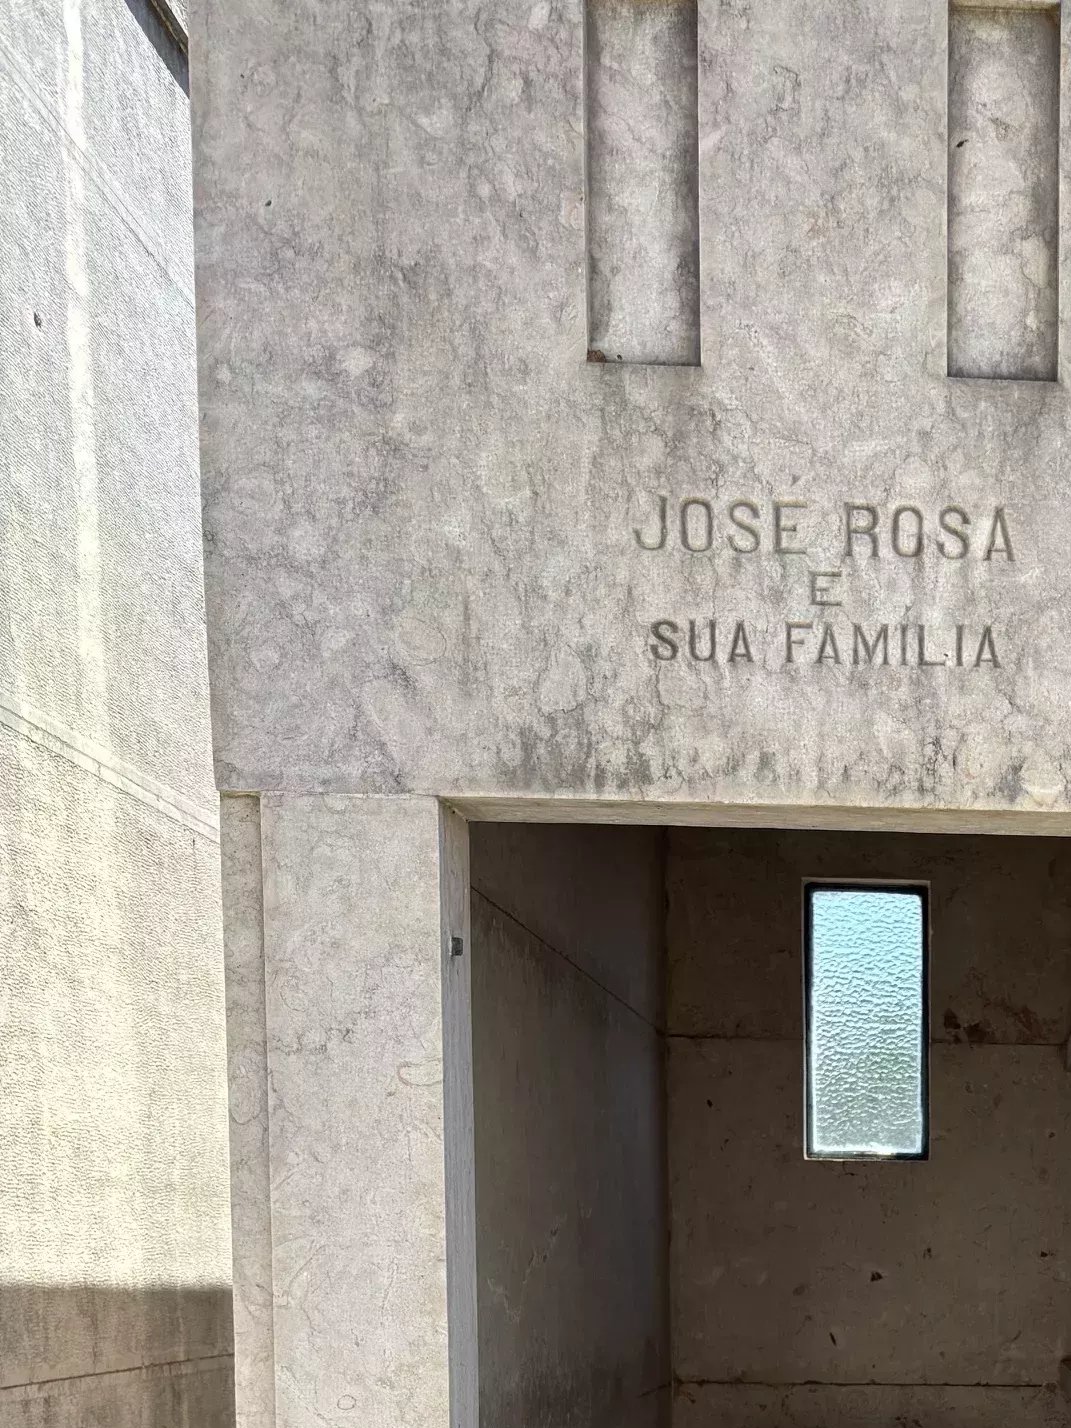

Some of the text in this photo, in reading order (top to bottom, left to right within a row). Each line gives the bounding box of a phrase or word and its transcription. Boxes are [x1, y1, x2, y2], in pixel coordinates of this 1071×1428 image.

[843, 502, 1015, 562] ROSA
[808, 570, 842, 606] E
[649, 619, 754, 663] SUA
